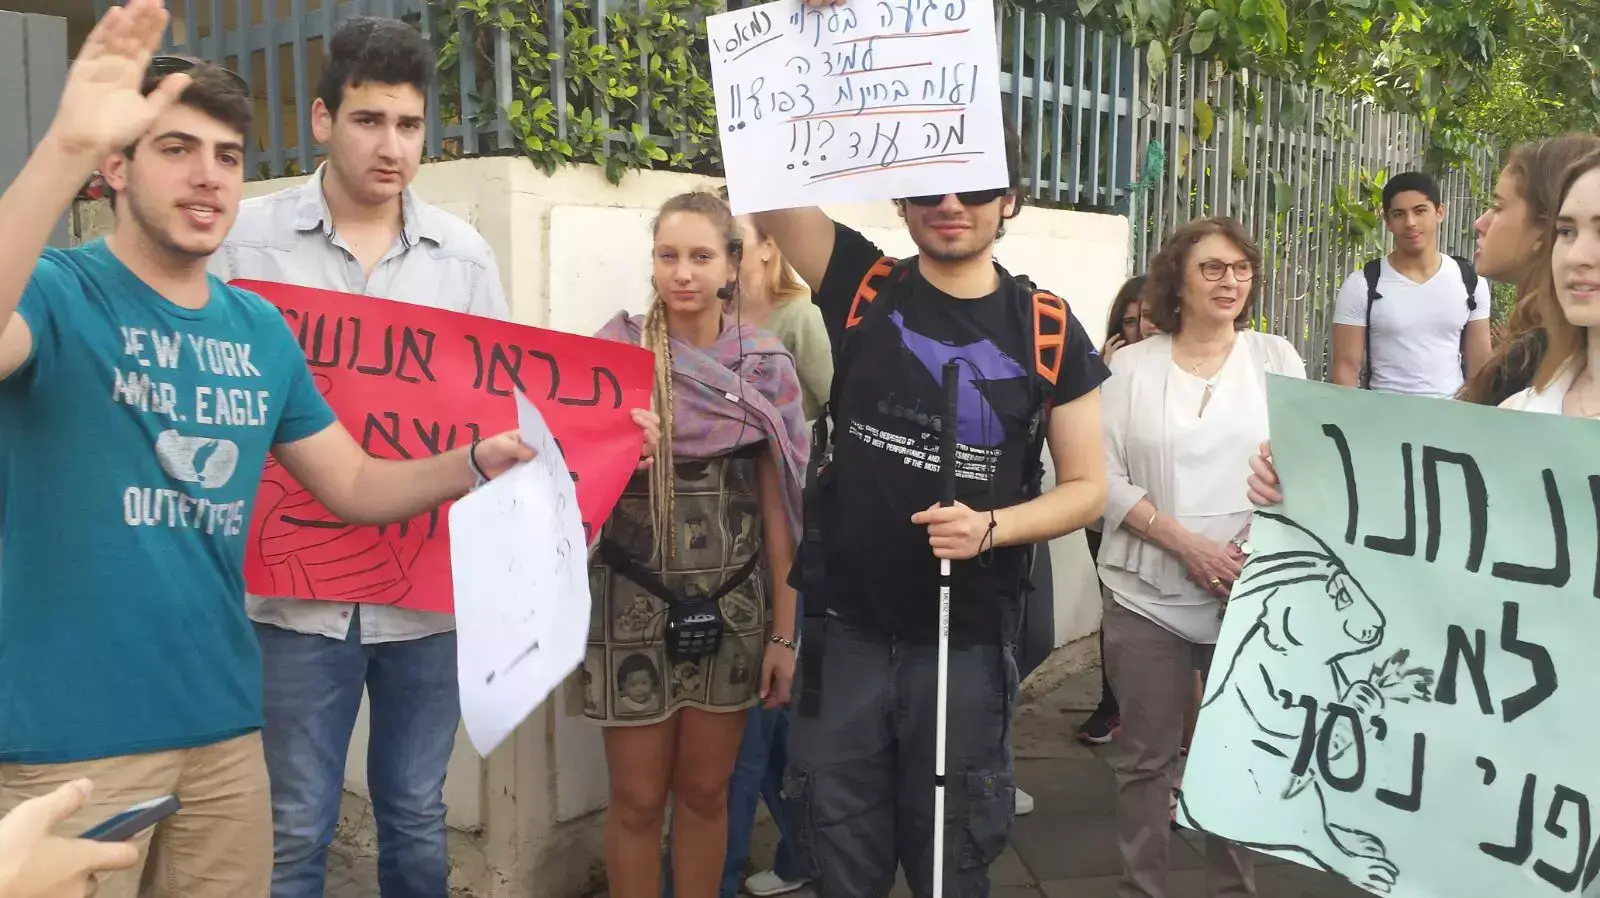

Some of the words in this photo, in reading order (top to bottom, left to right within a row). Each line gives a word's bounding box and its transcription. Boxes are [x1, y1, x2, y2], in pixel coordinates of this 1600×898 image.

[922, 114, 964, 153] מה
[187, 333, 261, 377] YORK
[276, 305, 437, 384] אנוש
[464, 334, 622, 409] תראו
[911, 459, 923, 469] THE
[924, 463, 941, 473] MOST
[1435, 601, 1558, 722] לא
[1279, 688, 1425, 812] ניסוי
